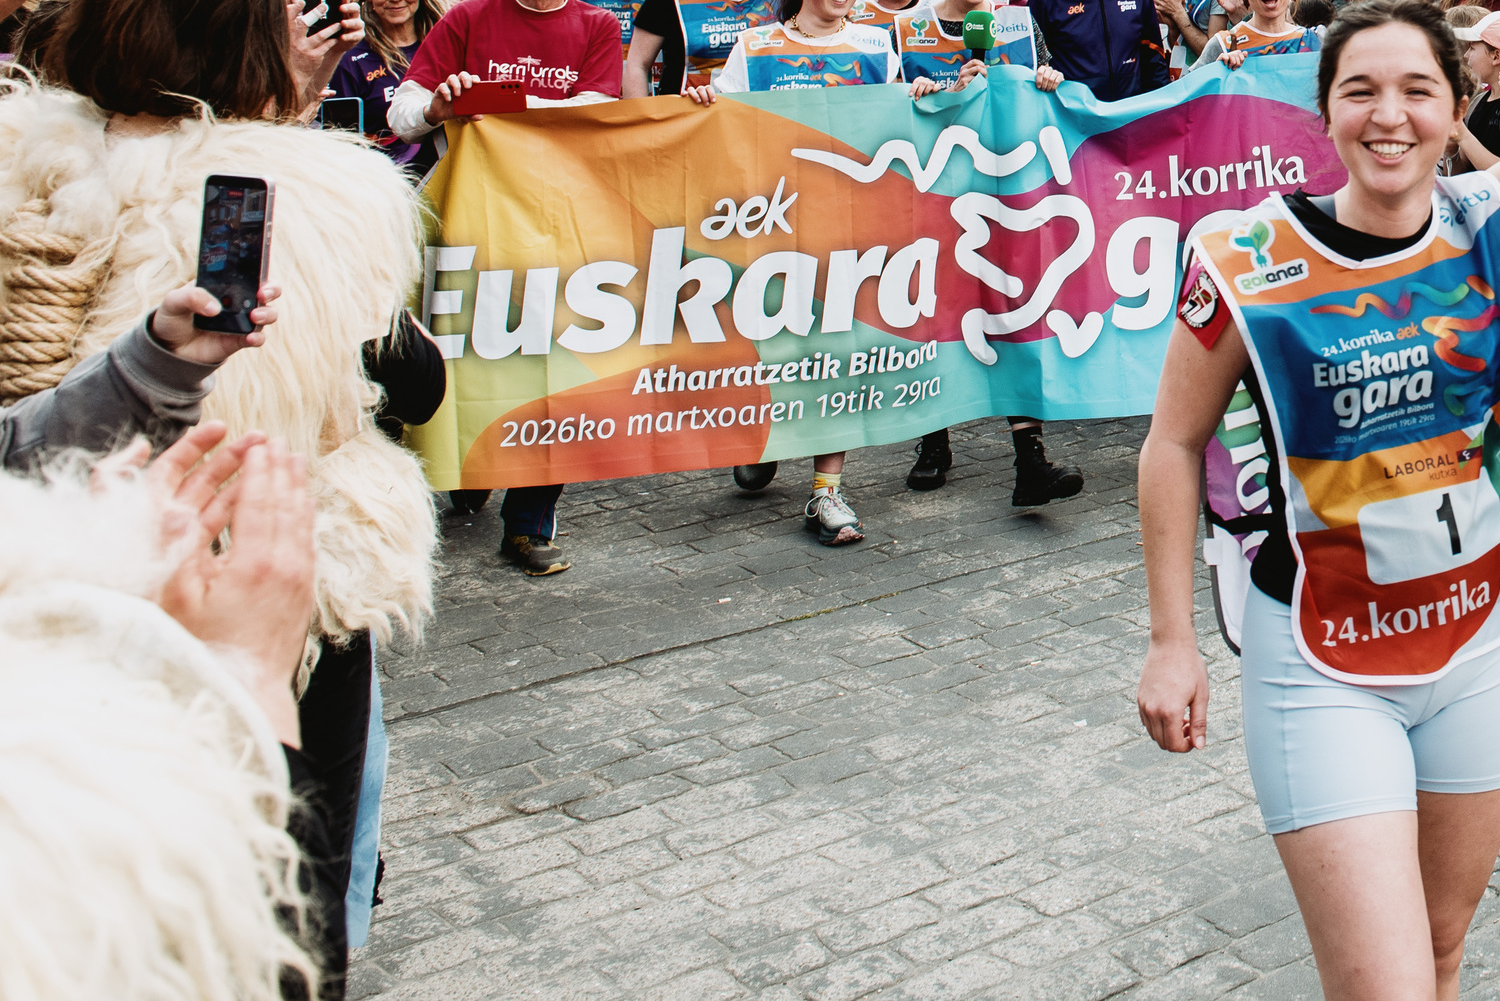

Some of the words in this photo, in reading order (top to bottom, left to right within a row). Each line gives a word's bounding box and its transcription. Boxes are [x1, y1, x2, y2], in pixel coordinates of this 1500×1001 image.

[1067, 2, 1085, 15] aek
[701, 21, 747, 34] Euskara
[708, 31, 740, 49] gar
[1004, 22, 1029, 34] eitb
[366, 64, 388, 82] aek
[488, 59, 526, 76] herri
[531, 65, 579, 82] urrats
[776, 72, 810, 83] 24.korrika
[931, 70, 960, 78] 24.korrik
[1113, 144, 1308, 201] 24.korrika
[699, 175, 799, 241] aek
[1455, 189, 1491, 225] eitb
[424, 225, 940, 360] Euskara
[1320, 329, 1395, 358] 24.korrika
[1395, 322, 1421, 340] aek
[631, 352, 842, 396] Atharratzetik
[848, 339, 939, 378] Bilbora
[1312, 344, 1430, 388] Euskara
[499, 413, 616, 448] 2026ko
[626, 398, 806, 437] martxoaren
[815, 390, 885, 418] 19tik
[891, 374, 942, 409] 29ra
[1332, 369, 1434, 429] gara
[1406, 402, 1435, 415] Bilbora
[1418, 413, 1436, 424] 29ra
[1384, 454, 1455, 479] LABORAL
[1428, 468, 1458, 482] kutxa
[1435, 492, 1462, 556] 1
[1320, 578, 1490, 648] 24.korrika
